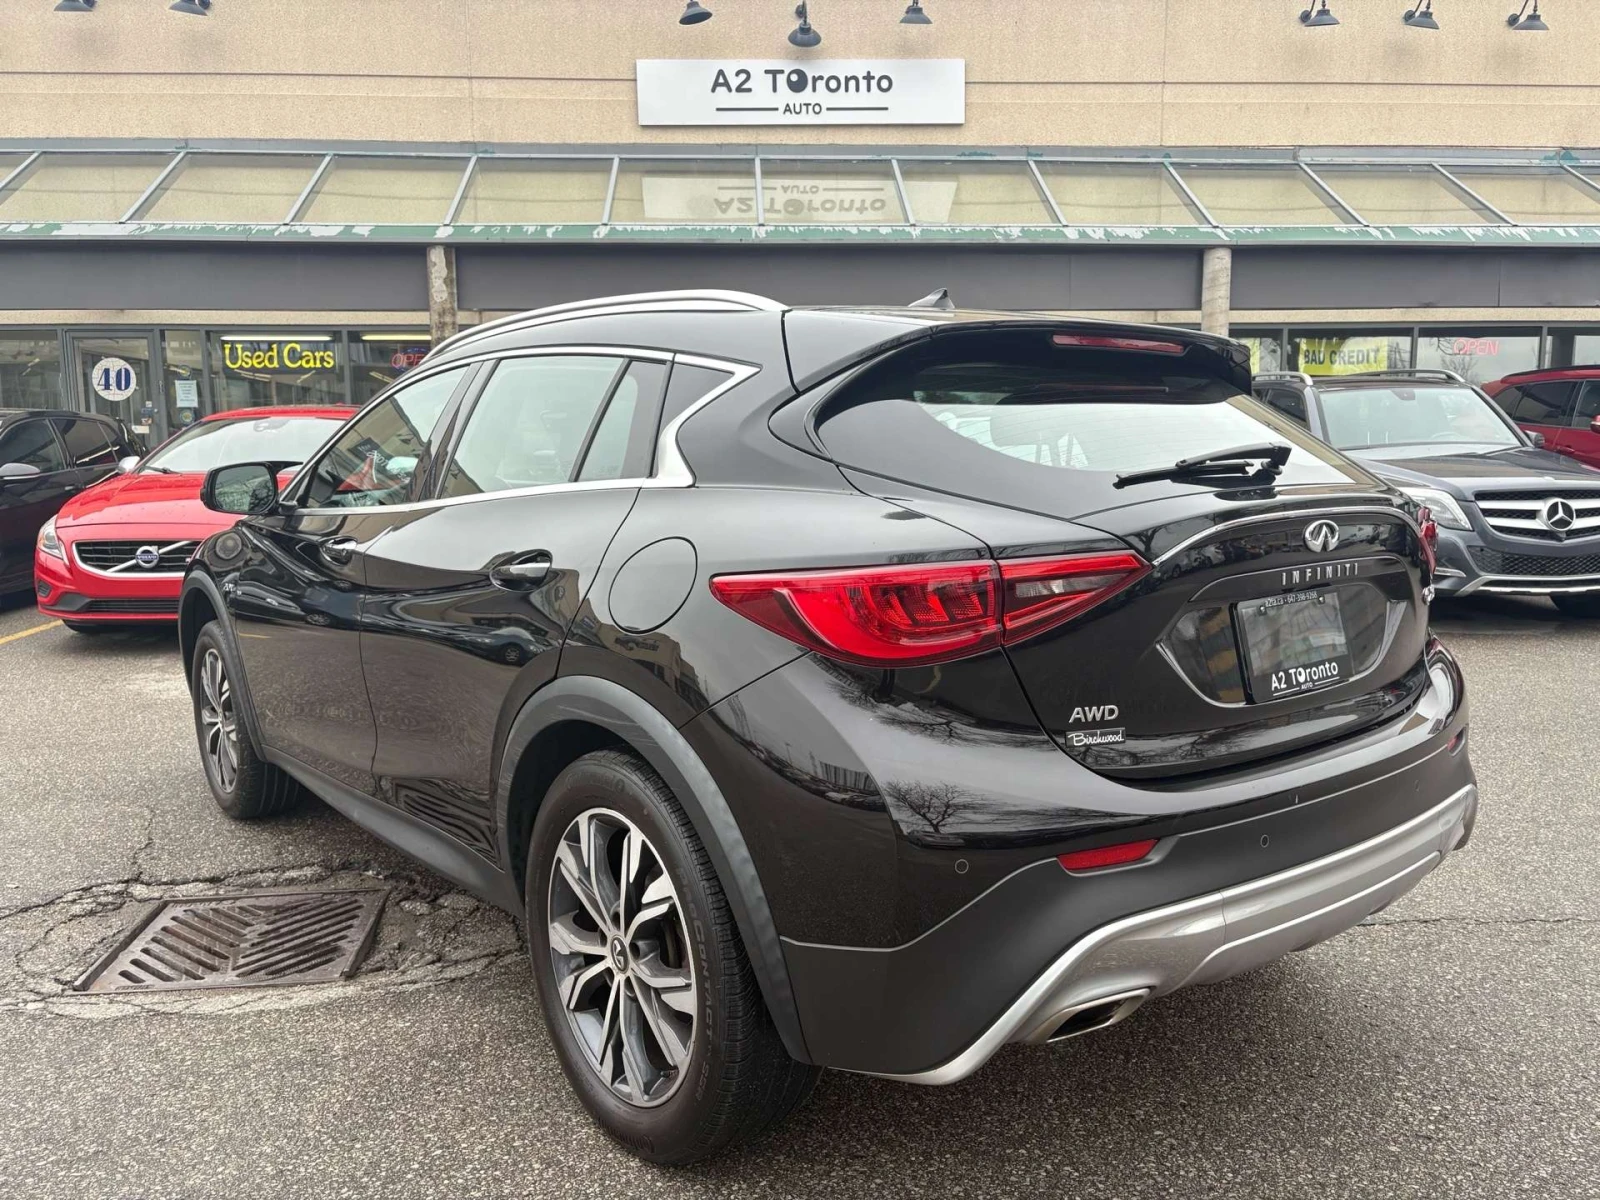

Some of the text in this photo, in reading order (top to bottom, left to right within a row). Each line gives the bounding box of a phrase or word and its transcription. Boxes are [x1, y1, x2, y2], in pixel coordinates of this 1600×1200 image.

[711, 68, 753, 94] A2
[783, 103, 822, 115] AUTO
[223, 342, 335, 369] Used Cars
[1304, 348, 1380, 365] BAD CREDIT
[1453, 338, 1499, 356] OPEN
[97, 367, 131, 391] 40
[1282, 562, 1359, 586] INFINITI
[1271, 669, 1287, 691] A2
[1301, 682, 1313, 690] AUTO
[1068, 705, 1119, 724] AWD
[1067, 730, 1125, 746] Birchwood
